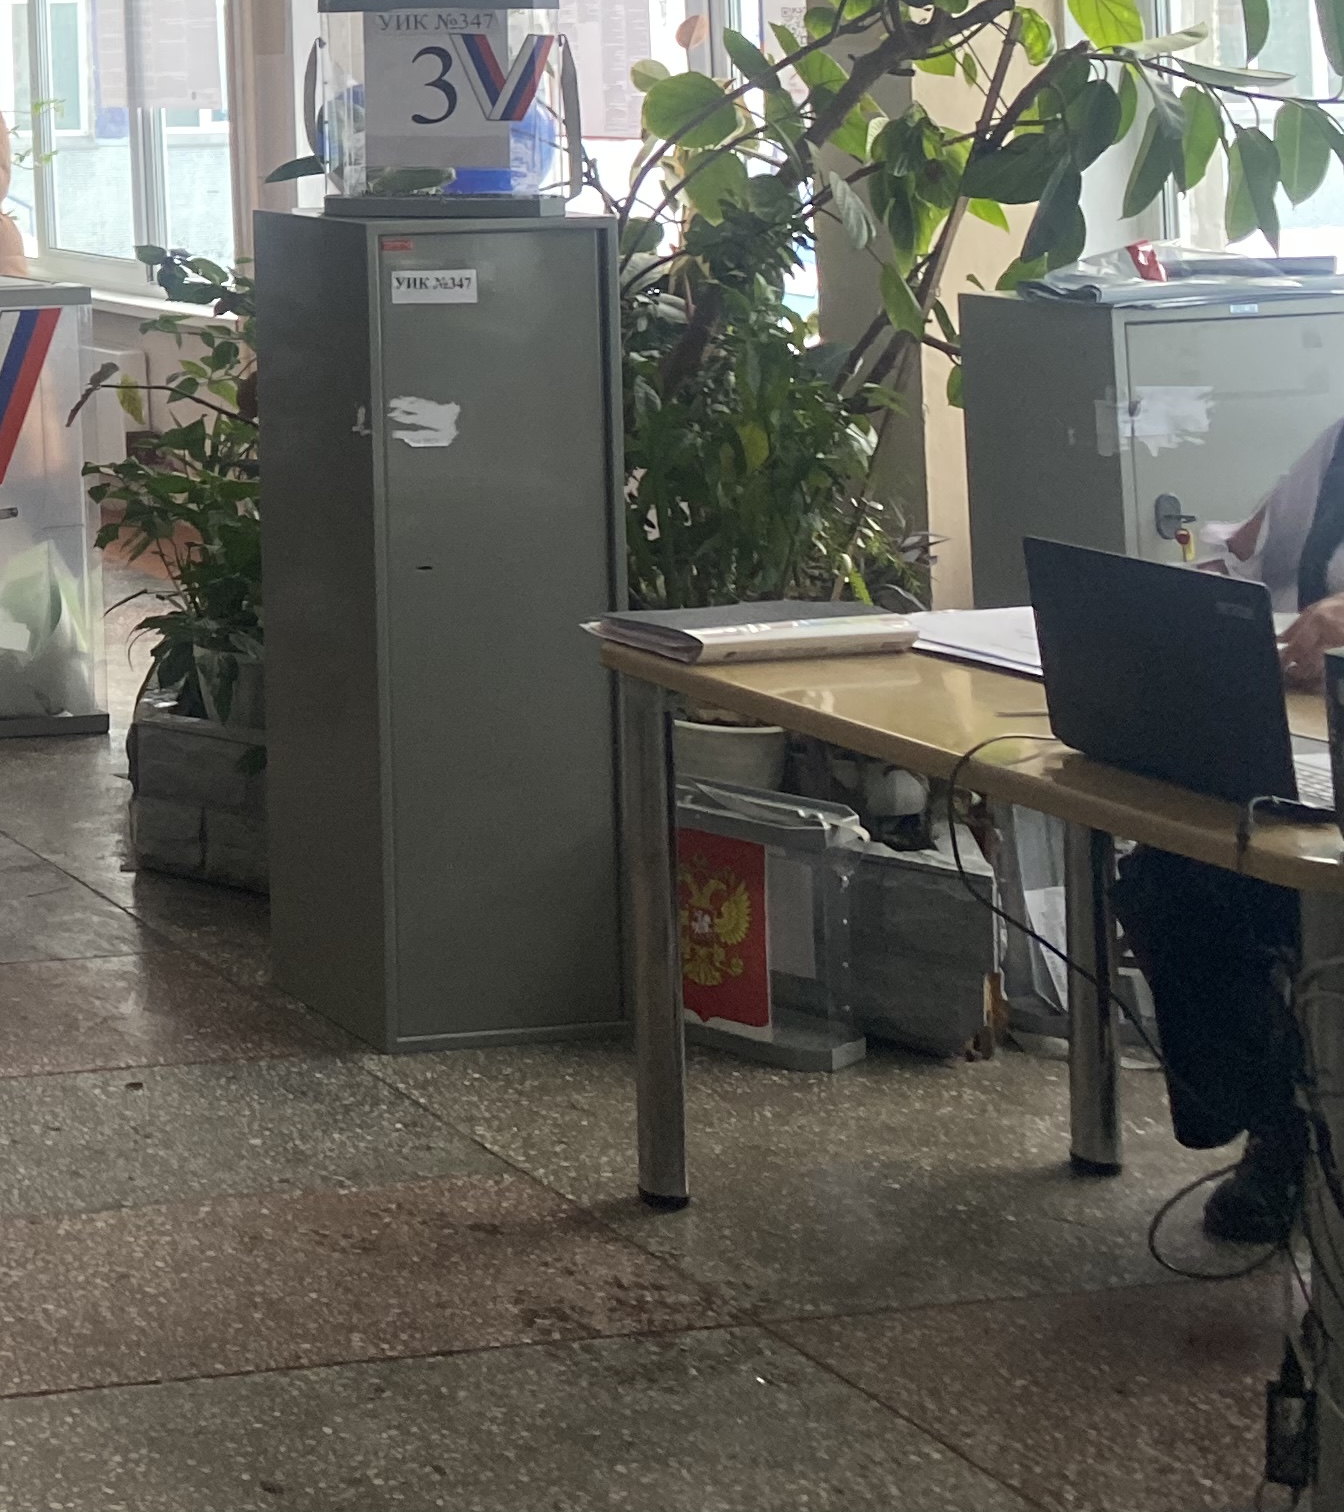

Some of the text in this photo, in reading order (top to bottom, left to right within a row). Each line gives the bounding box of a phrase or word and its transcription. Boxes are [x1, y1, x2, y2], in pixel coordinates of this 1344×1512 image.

[378, 13, 494, 31] УИК №347
[411, 46, 457, 124] 3
[395, 276, 472, 290] УИК №347
